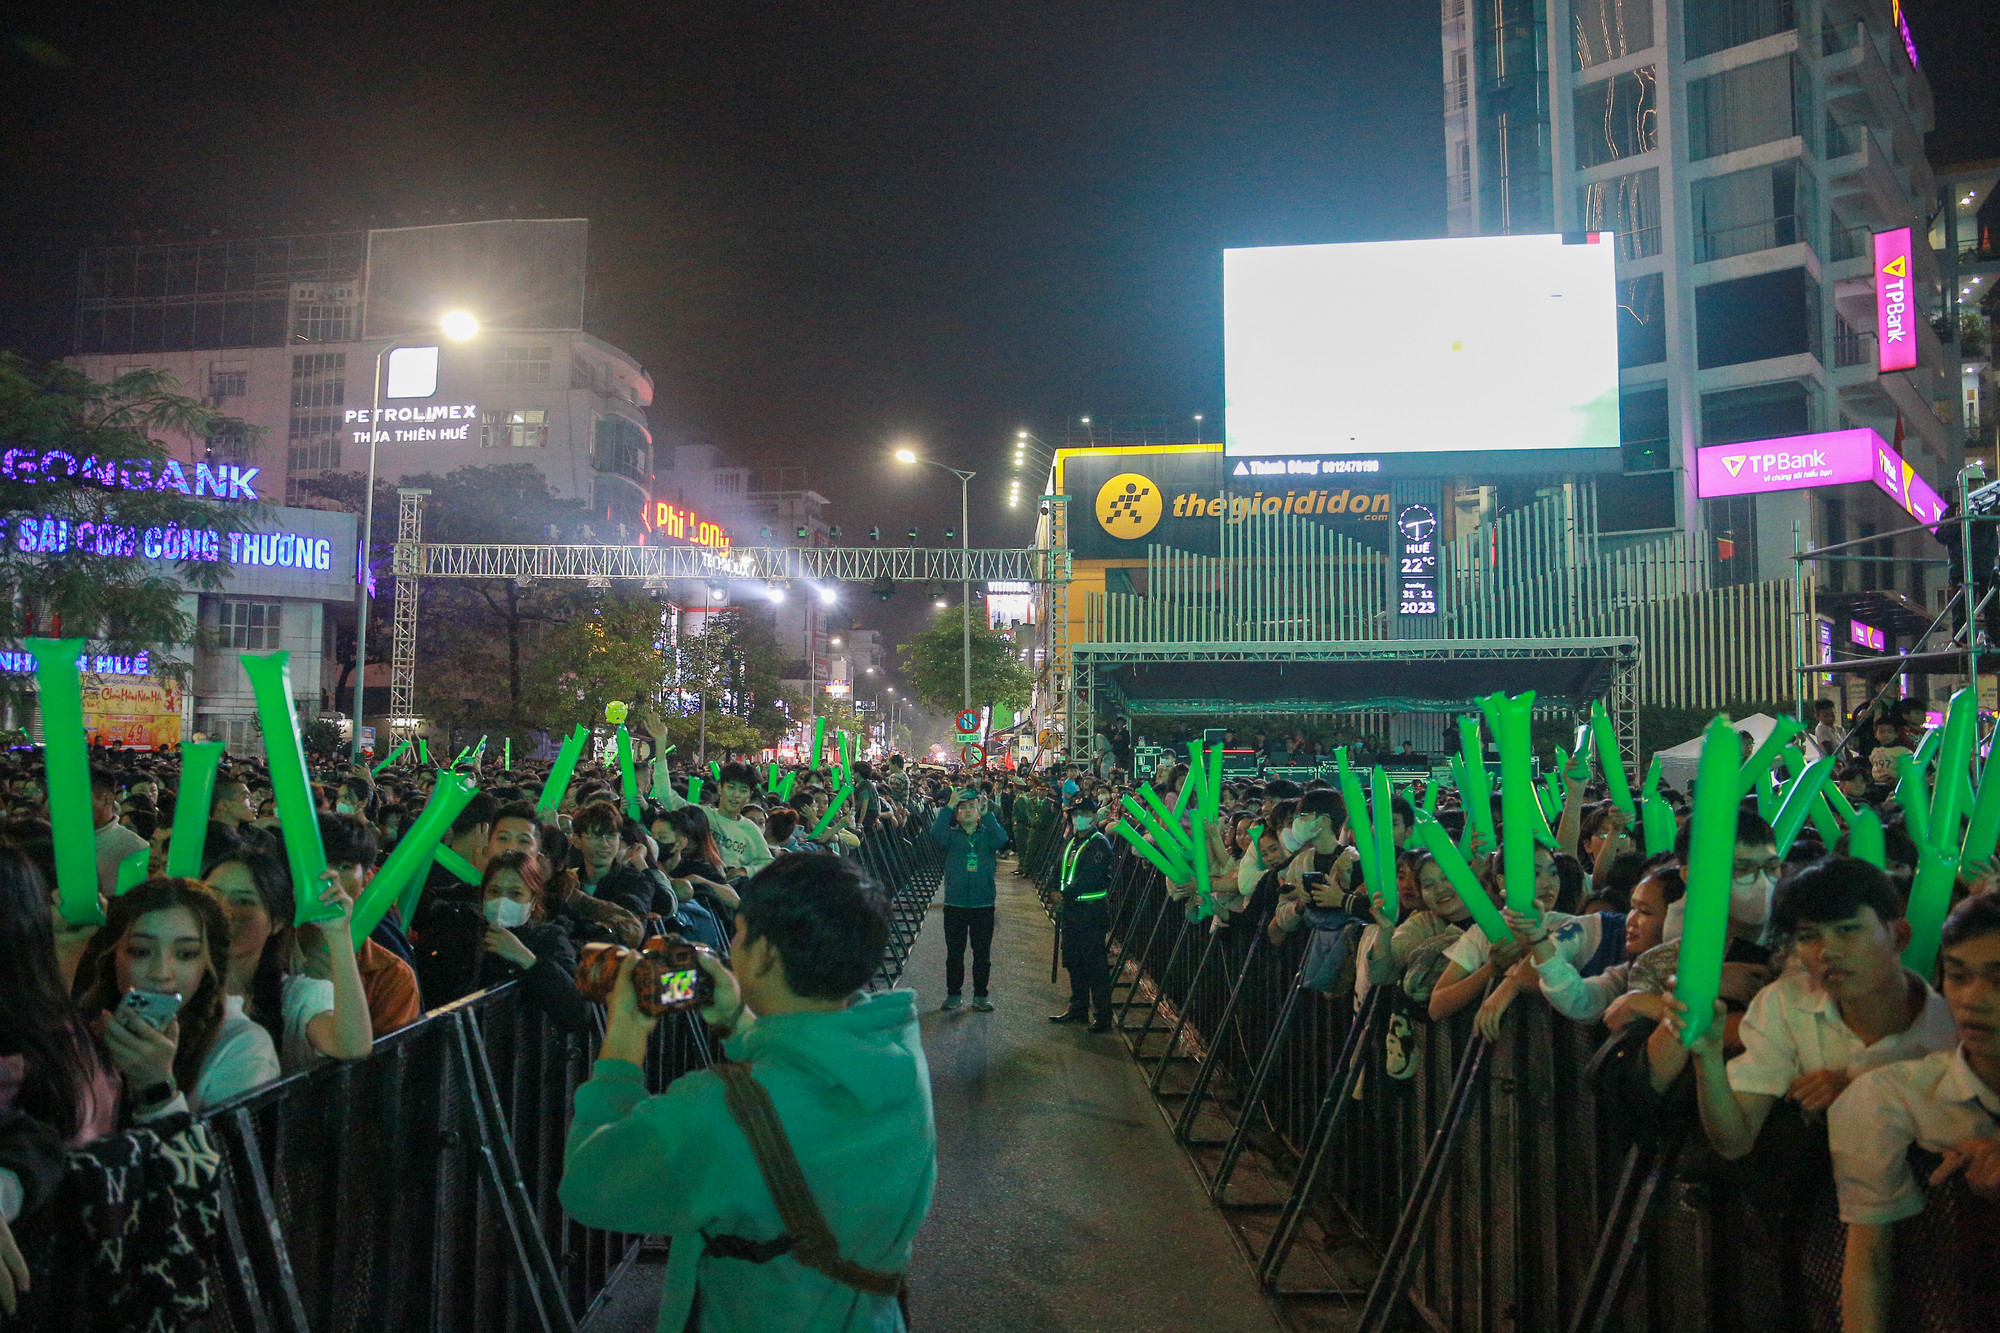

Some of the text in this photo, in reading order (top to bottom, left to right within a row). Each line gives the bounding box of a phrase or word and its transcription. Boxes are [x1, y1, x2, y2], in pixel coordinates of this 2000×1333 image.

[1885, 279, 1906, 344] TPBank
[345, 405, 476, 423] PETROLIMEX
[395, 427, 436, 441] THIÊN
[440, 424, 470, 440] HUẾ
[1749, 448, 1826, 474] TPBank
[657, 502, 730, 558] Phi Long
[143, 520, 219, 562] CÔNG
[227, 532, 331, 570] THƯƠNG
[1406, 541, 1431, 554] HUẾ
[1402, 590, 1415, 599] 31
[1421, 590, 1434, 599] 12
[1400, 602, 1436, 614] 2023
[96, 650, 150, 675] HUẾ
